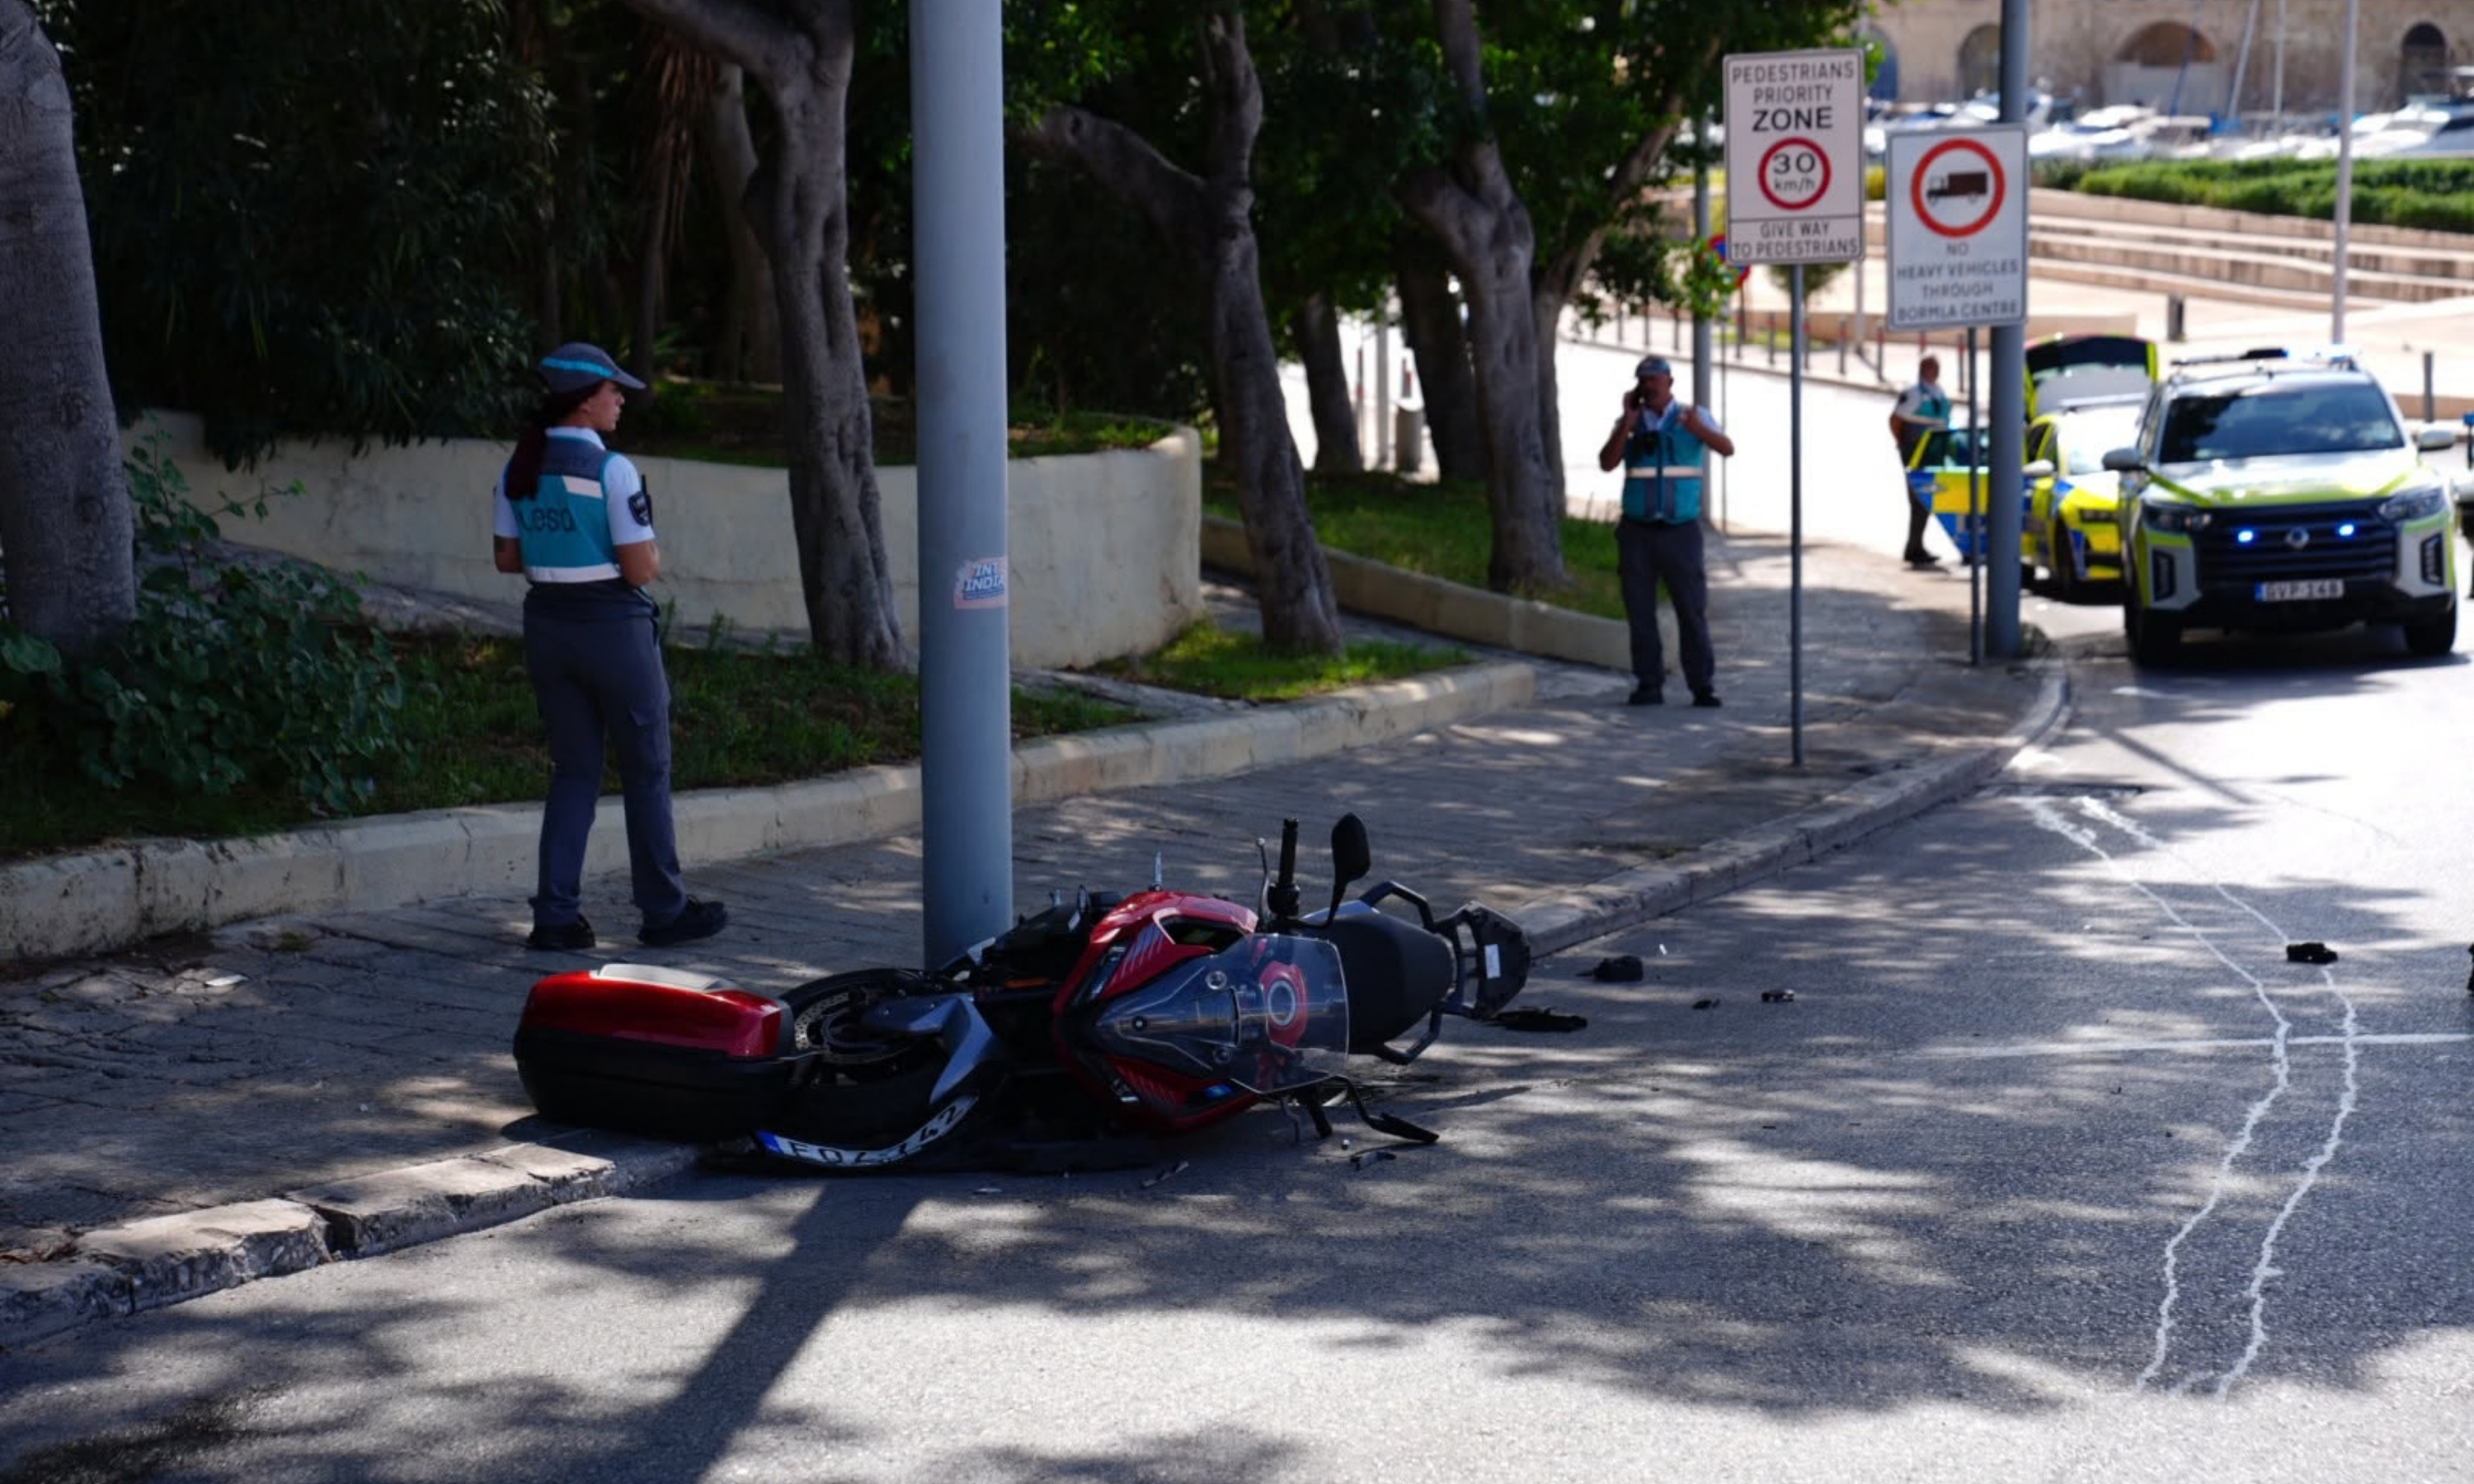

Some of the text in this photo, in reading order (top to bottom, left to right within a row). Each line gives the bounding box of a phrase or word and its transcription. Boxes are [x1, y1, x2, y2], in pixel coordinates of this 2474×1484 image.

[1733, 61, 1855, 83] PEDESTRIANS
[1754, 85, 1832, 104] PRIORITY
[1752, 106, 1833, 132] ZONE
[1773, 153, 1816, 175] 30
[1775, 177, 1815, 192] km/h
[1761, 222, 1829, 238] GIVE WAY
[1733, 238, 1857, 257] TO PEDESTRIANS
[1946, 242, 1969, 256] NO
[1898, 259, 2018, 279] HEAVY VEHICLES
[1922, 283, 1993, 298] THROUGH
[1898, 300, 2017, 322] BORMLA CENTRE
